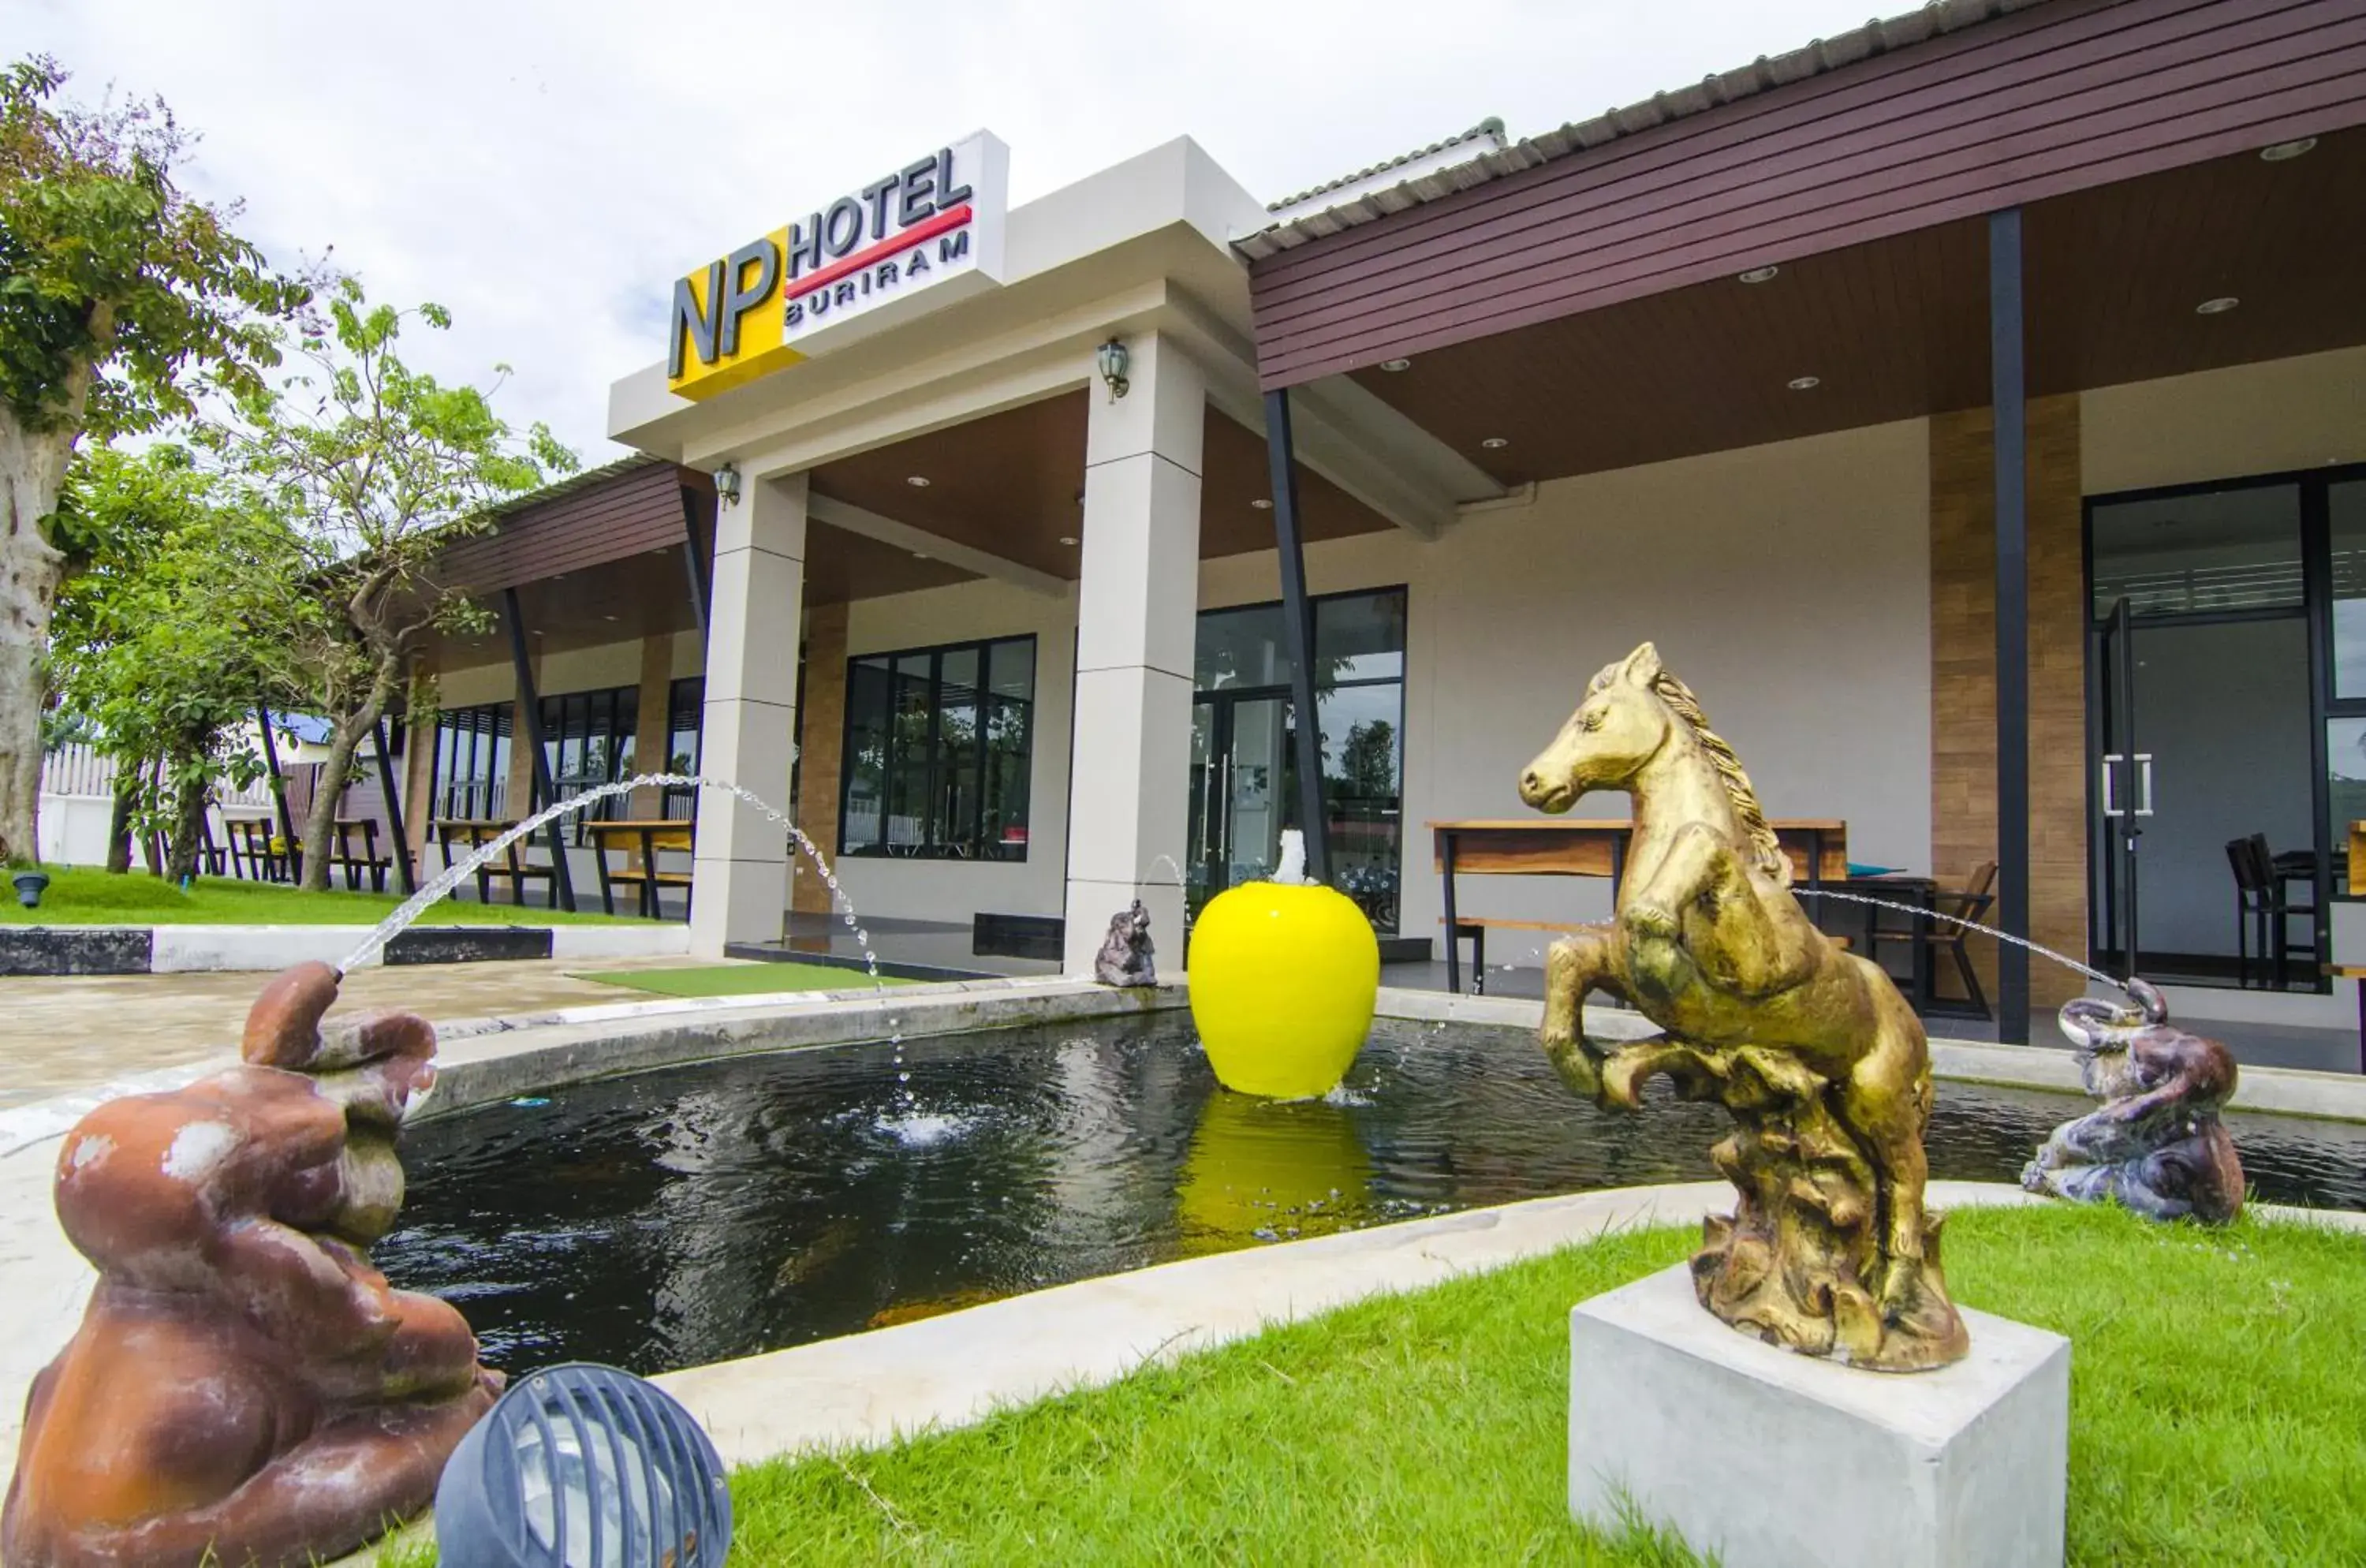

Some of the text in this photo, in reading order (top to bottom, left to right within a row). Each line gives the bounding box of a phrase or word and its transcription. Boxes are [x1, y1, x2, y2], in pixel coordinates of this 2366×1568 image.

[668, 147, 972, 379] NP HOTEL
[784, 230, 968, 327] BURIRAM
